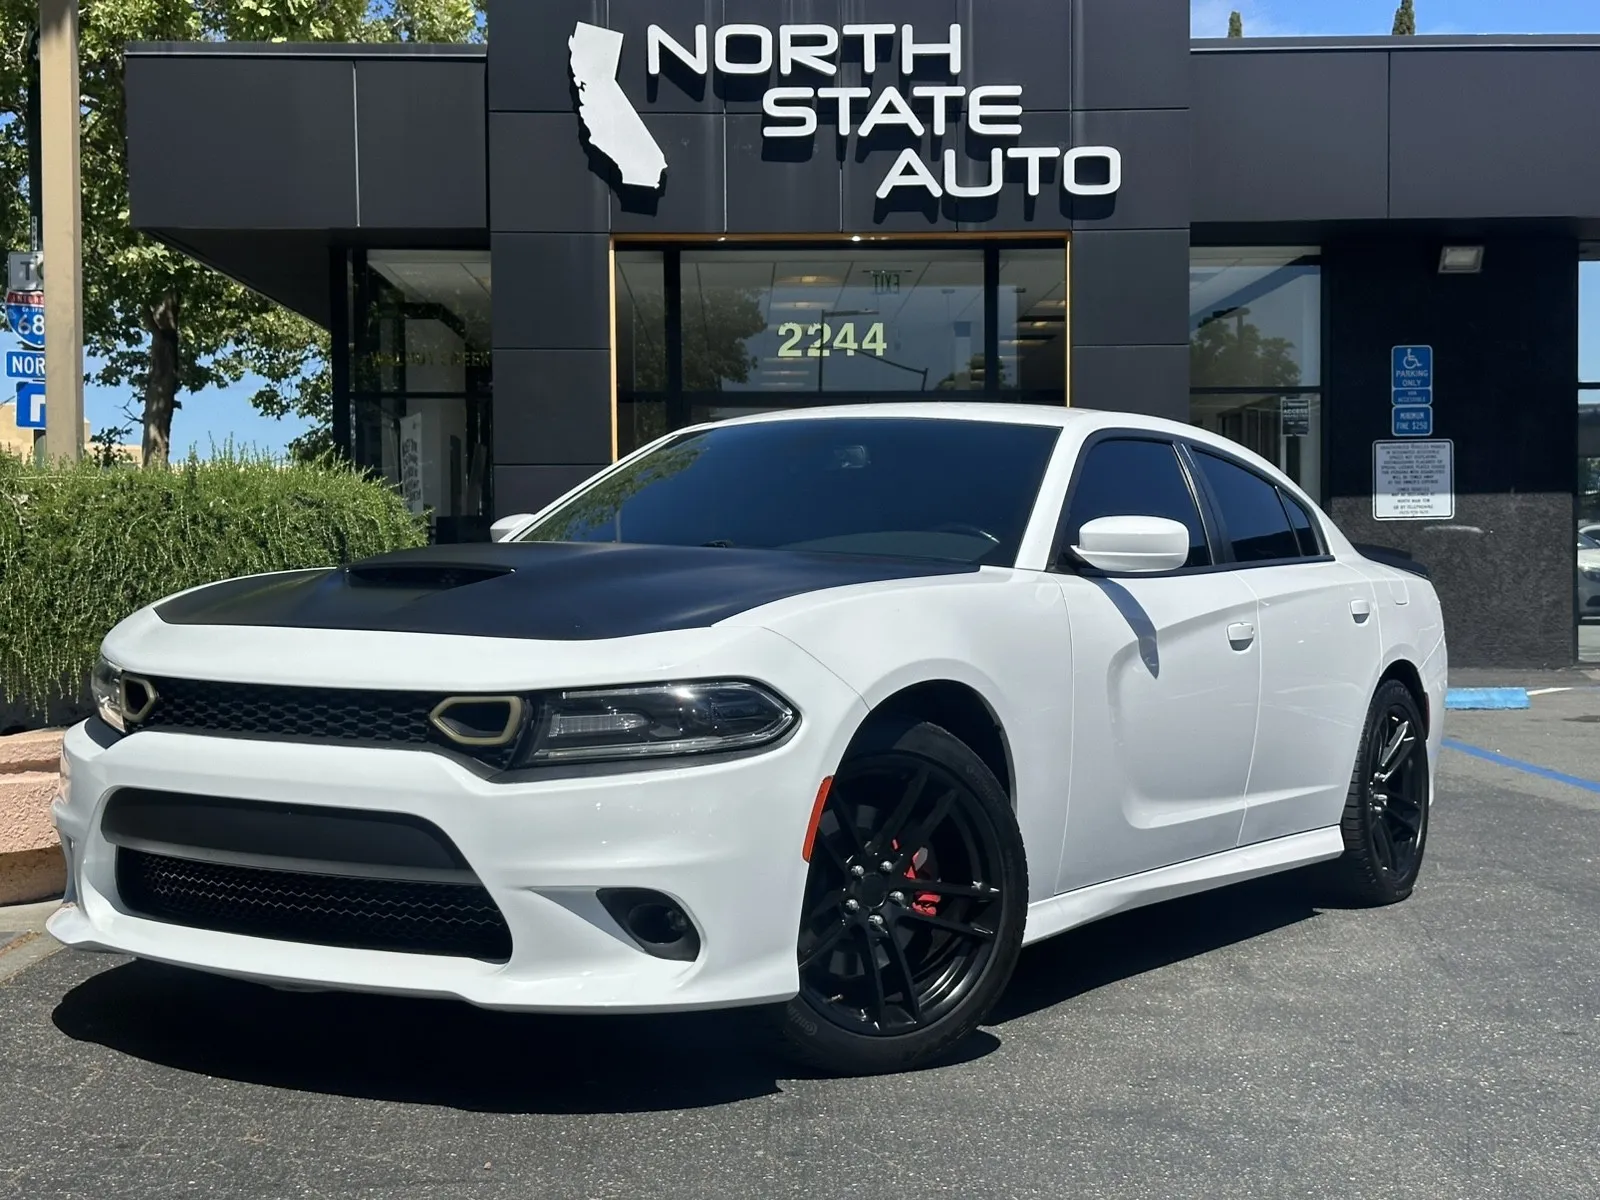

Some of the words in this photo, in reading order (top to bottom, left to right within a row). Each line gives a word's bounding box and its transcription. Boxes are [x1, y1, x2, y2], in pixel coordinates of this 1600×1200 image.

[647, 23, 962, 75] NORTH
[762, 85, 1023, 138] STATE
[875, 145, 1122, 199] AUTO
[777, 322, 888, 357] 2244
[1395, 369, 1429, 378] PARKING
[1402, 379, 1421, 387] ONLY
[1396, 421, 1410, 430] FINE
[1412, 421, 1428, 430] $250
